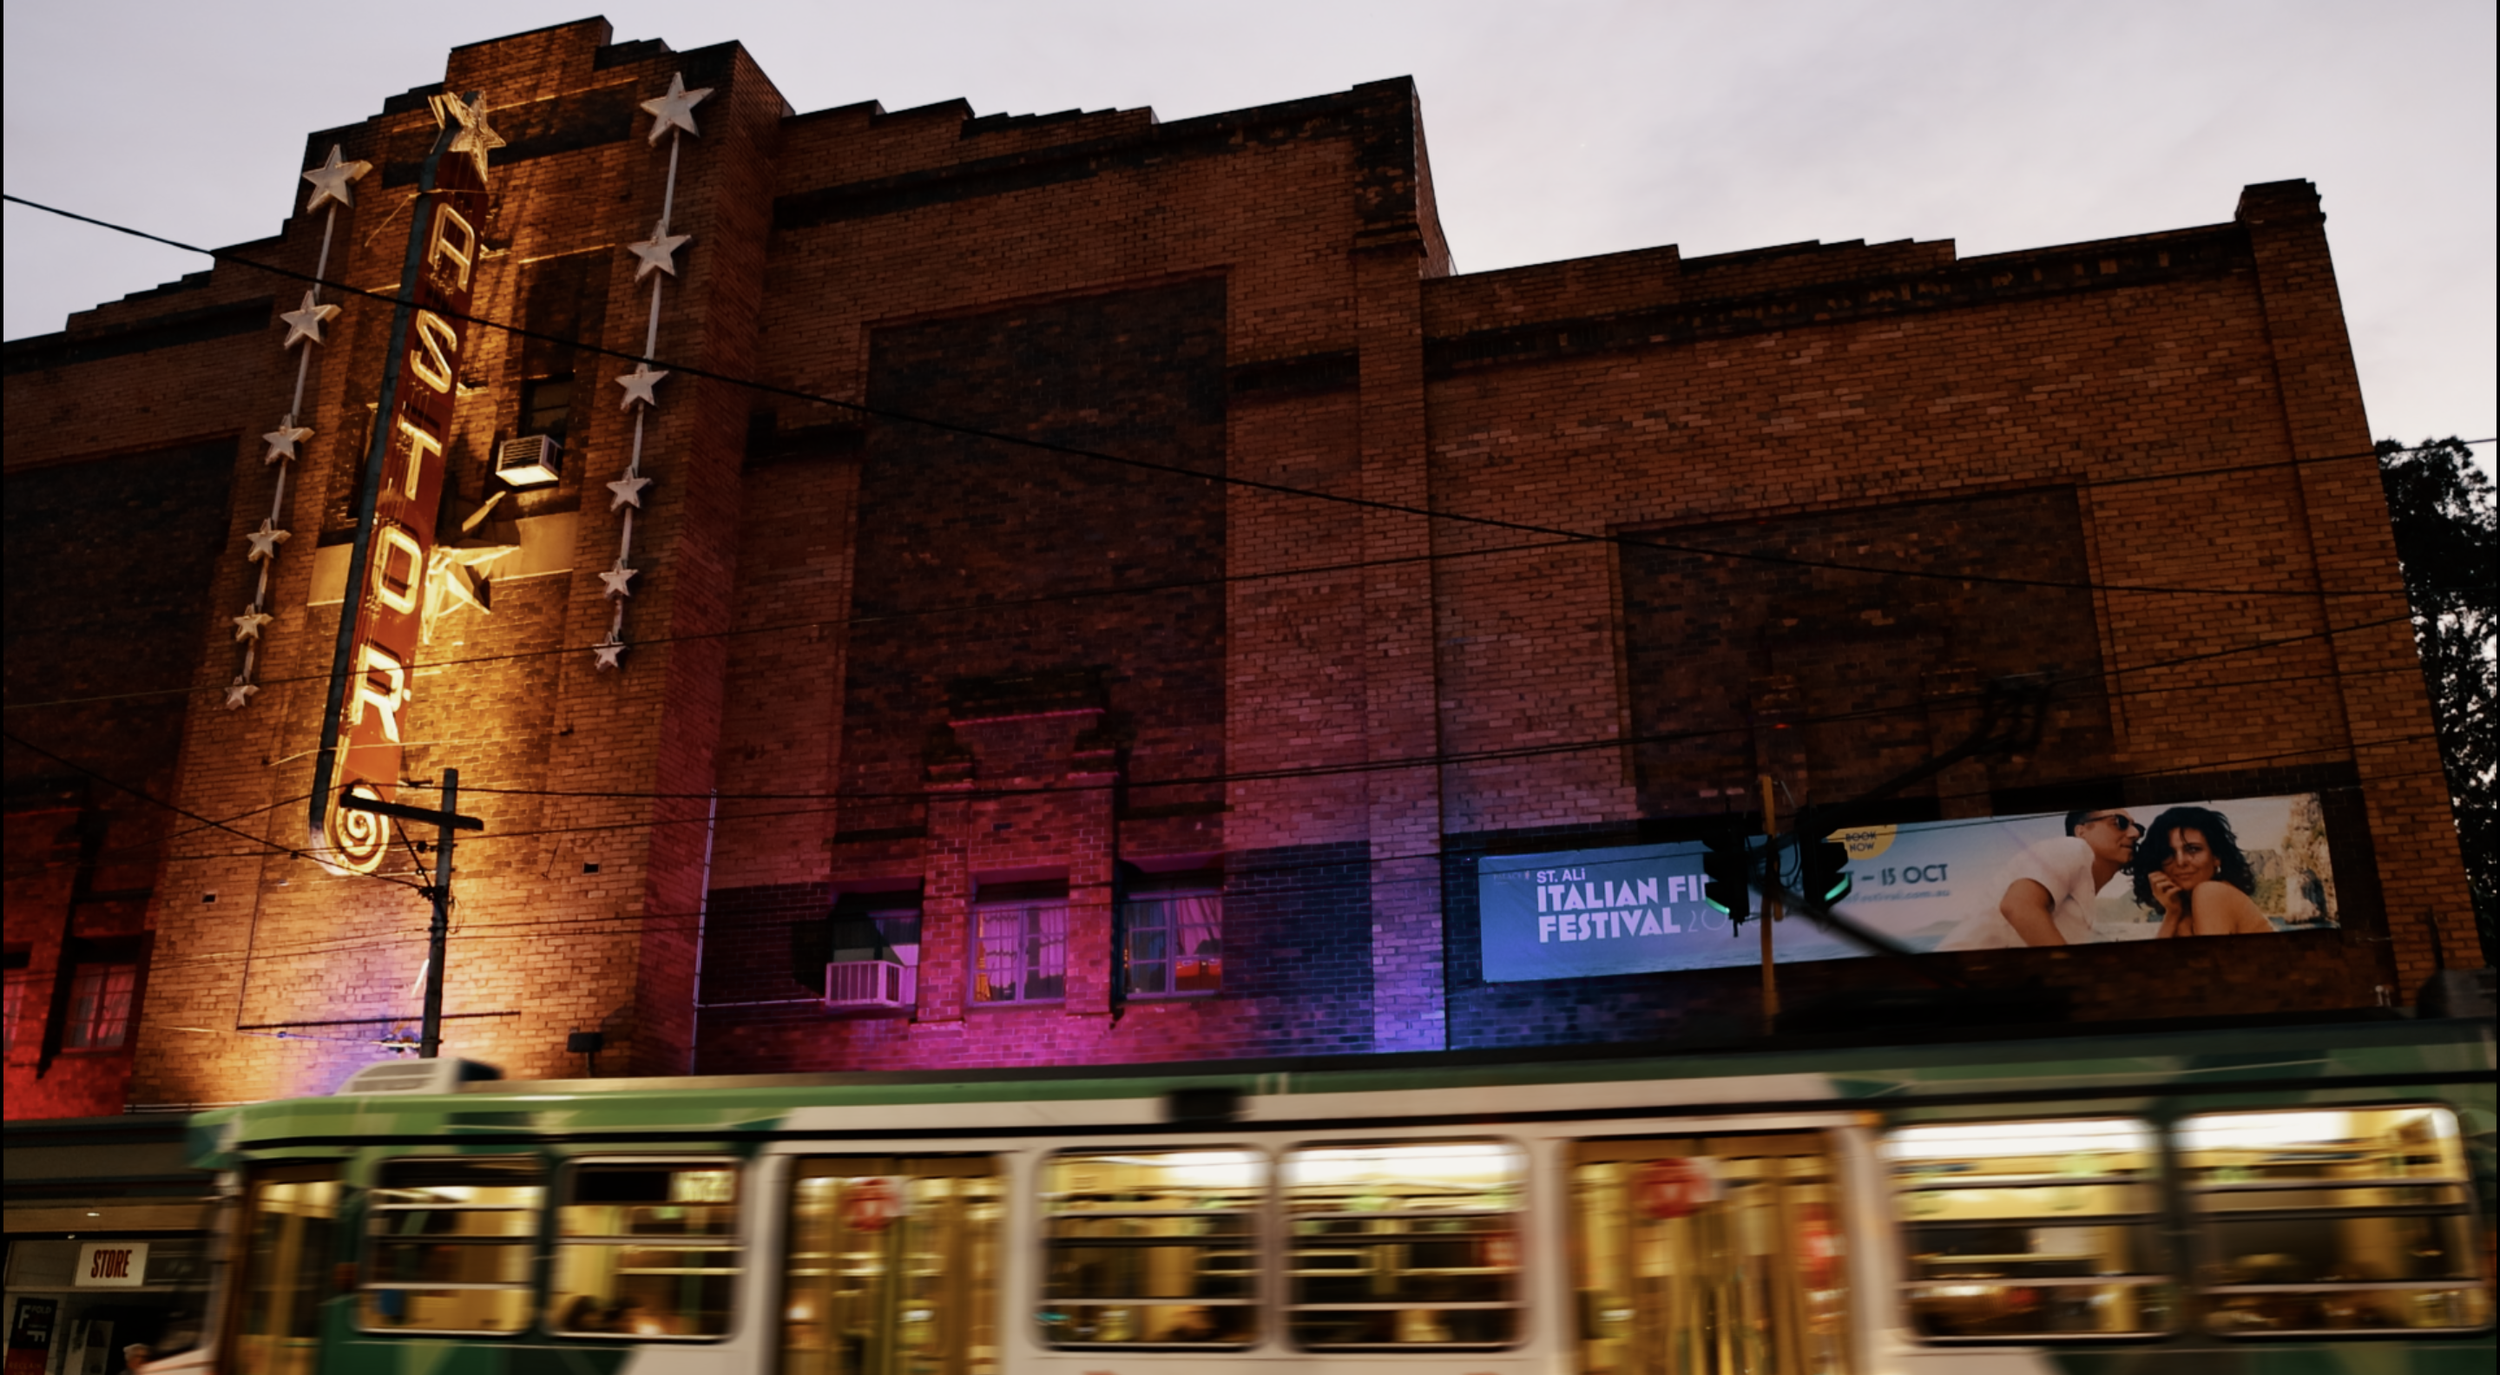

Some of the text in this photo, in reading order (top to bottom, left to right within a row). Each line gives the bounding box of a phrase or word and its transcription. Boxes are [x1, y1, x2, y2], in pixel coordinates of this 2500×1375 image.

[351, 202, 476, 744] ASTOR
[1845, 831, 1877, 842] BOOK
[1849, 842, 1875, 853] NOW
[1536, 869, 1559, 884] ST.
[1903, 863, 1948, 884] OCT
[1536, 874, 1711, 913] ITALIAN FI
[1538, 907, 1681, 943] FESTIVAL
[91, 1249, 133, 1279] STORE
